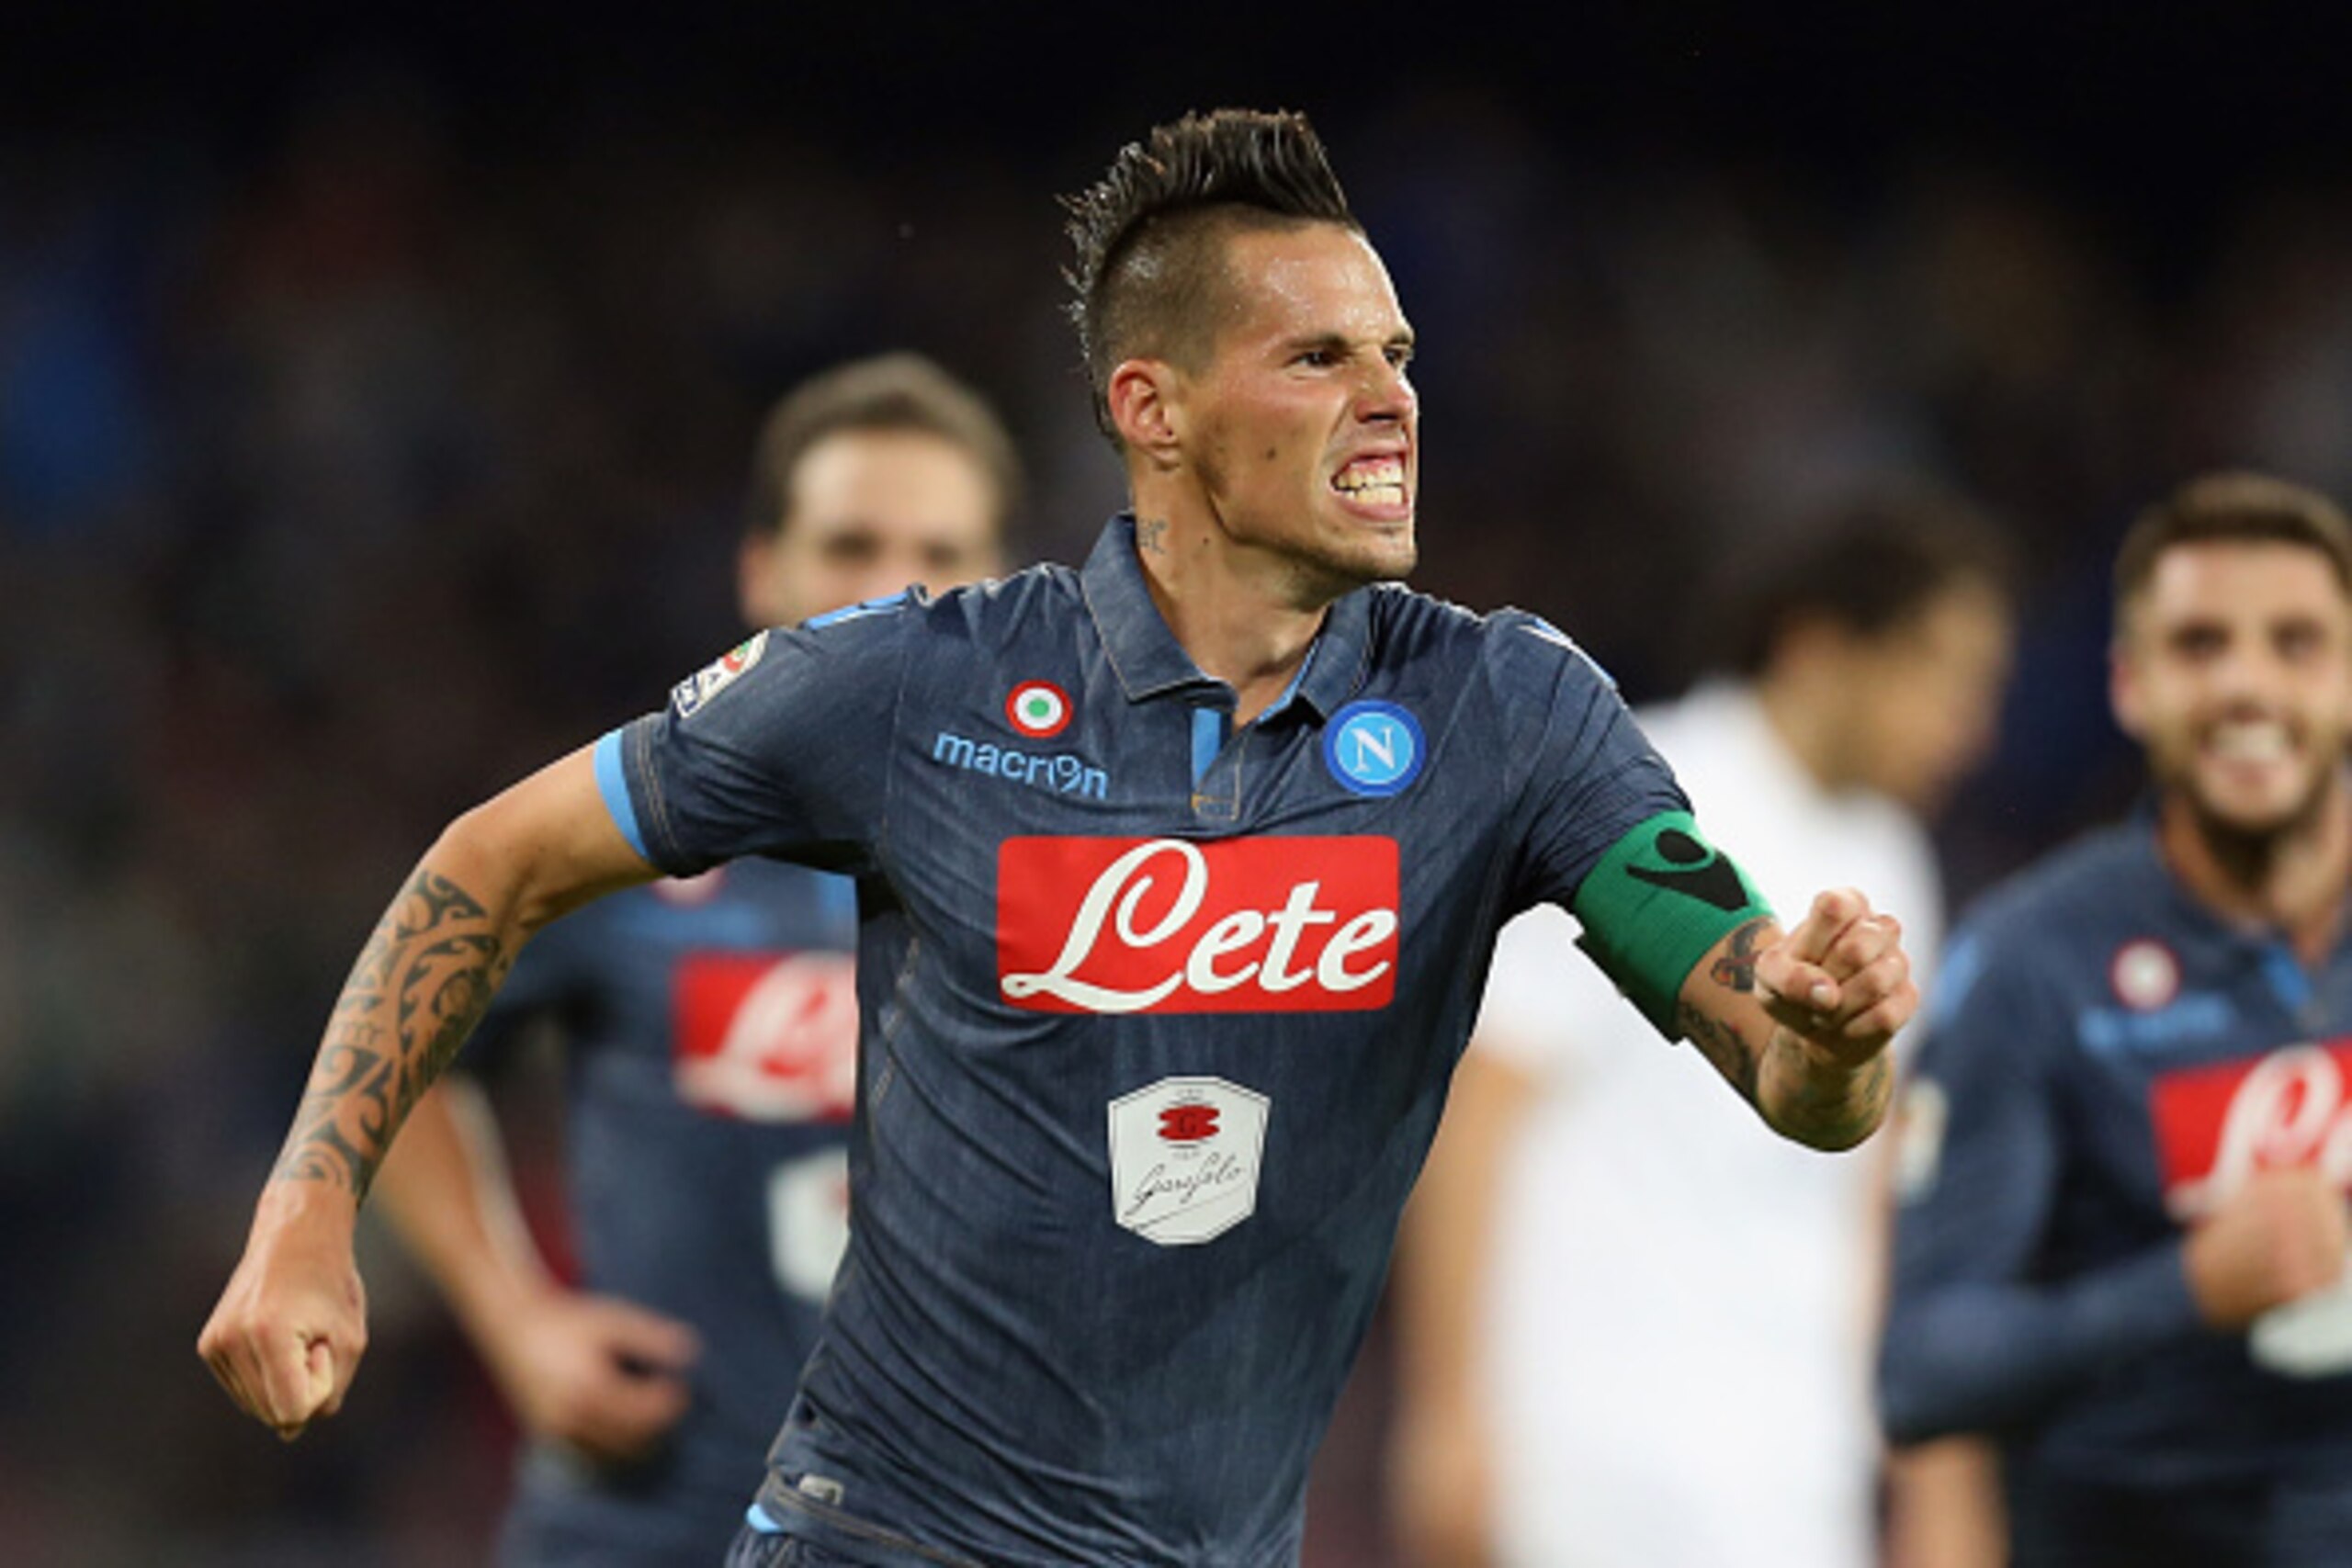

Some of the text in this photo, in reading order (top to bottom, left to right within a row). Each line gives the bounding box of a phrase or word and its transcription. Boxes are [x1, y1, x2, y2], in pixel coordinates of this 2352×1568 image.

[933, 732, 1109, 799] macron
[1351, 726, 1396, 773] N
[1001, 839, 1397, 1013] Lete
